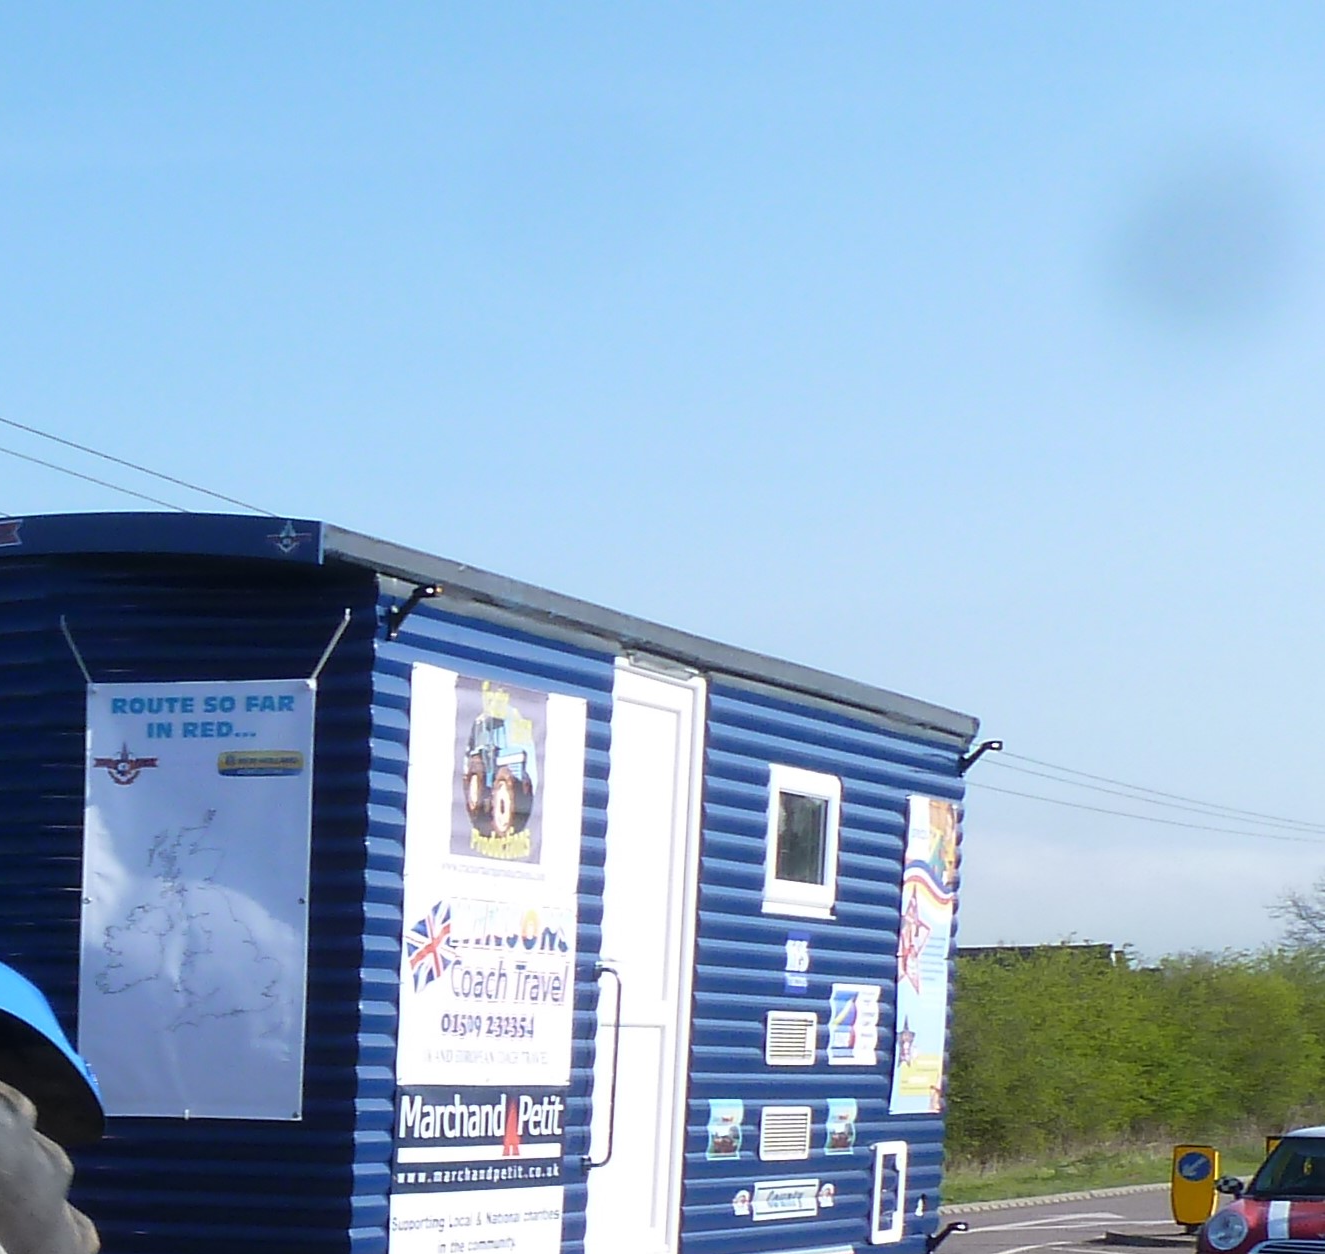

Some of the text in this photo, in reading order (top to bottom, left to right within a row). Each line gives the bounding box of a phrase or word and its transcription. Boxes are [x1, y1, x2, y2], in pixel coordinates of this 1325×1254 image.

[111, 695, 295, 714] ROUTE SO FAR
[147, 721, 257, 738] IN RED...
[451, 960, 570, 1002] Coach Travel
[398, 1094, 564, 1138] Marchand Petit
[397, 1163, 560, 1184] www.marchandpetit.co.uk
[392, 1216, 445, 1233] Supporting
